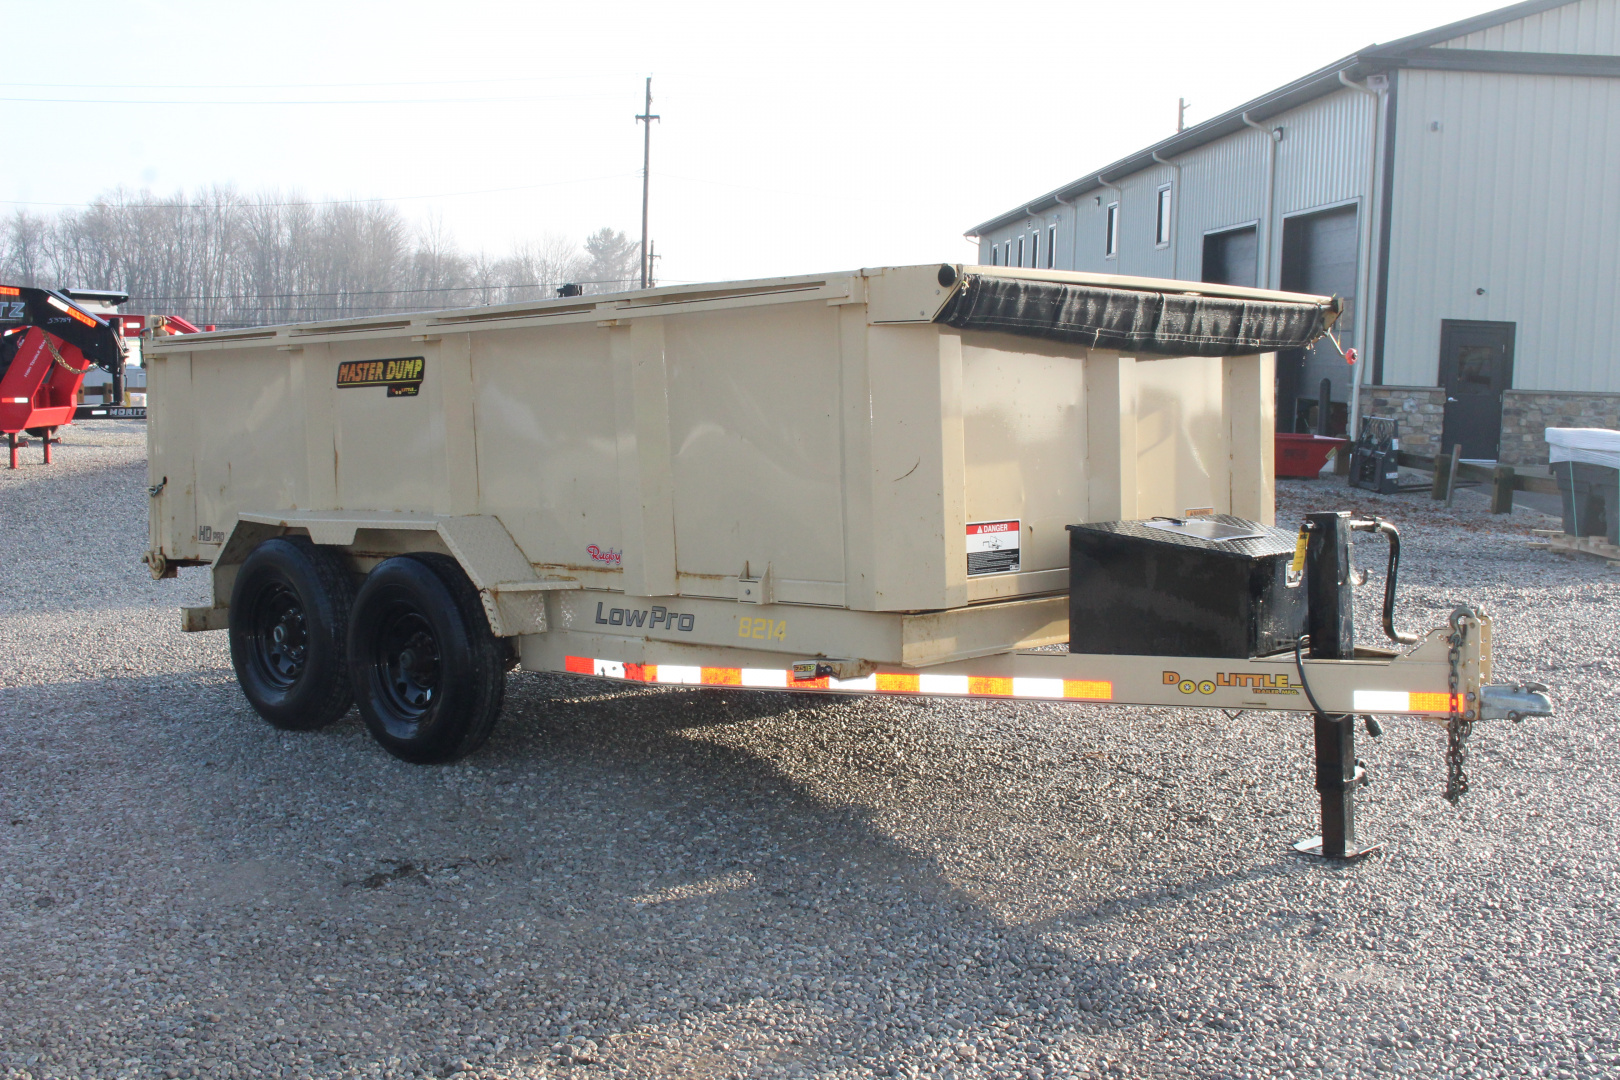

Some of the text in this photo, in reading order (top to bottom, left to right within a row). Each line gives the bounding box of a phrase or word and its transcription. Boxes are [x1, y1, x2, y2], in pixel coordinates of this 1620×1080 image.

[338, 359, 422, 382] MASTER DUMP
[198, 525, 212, 541] HD
[983, 524, 1008, 532] DANGER
[586, 544, 622, 565] Rugby
[738, 617, 787, 641] 8214
[1162, 671, 1289, 695] DOOLITTLE
